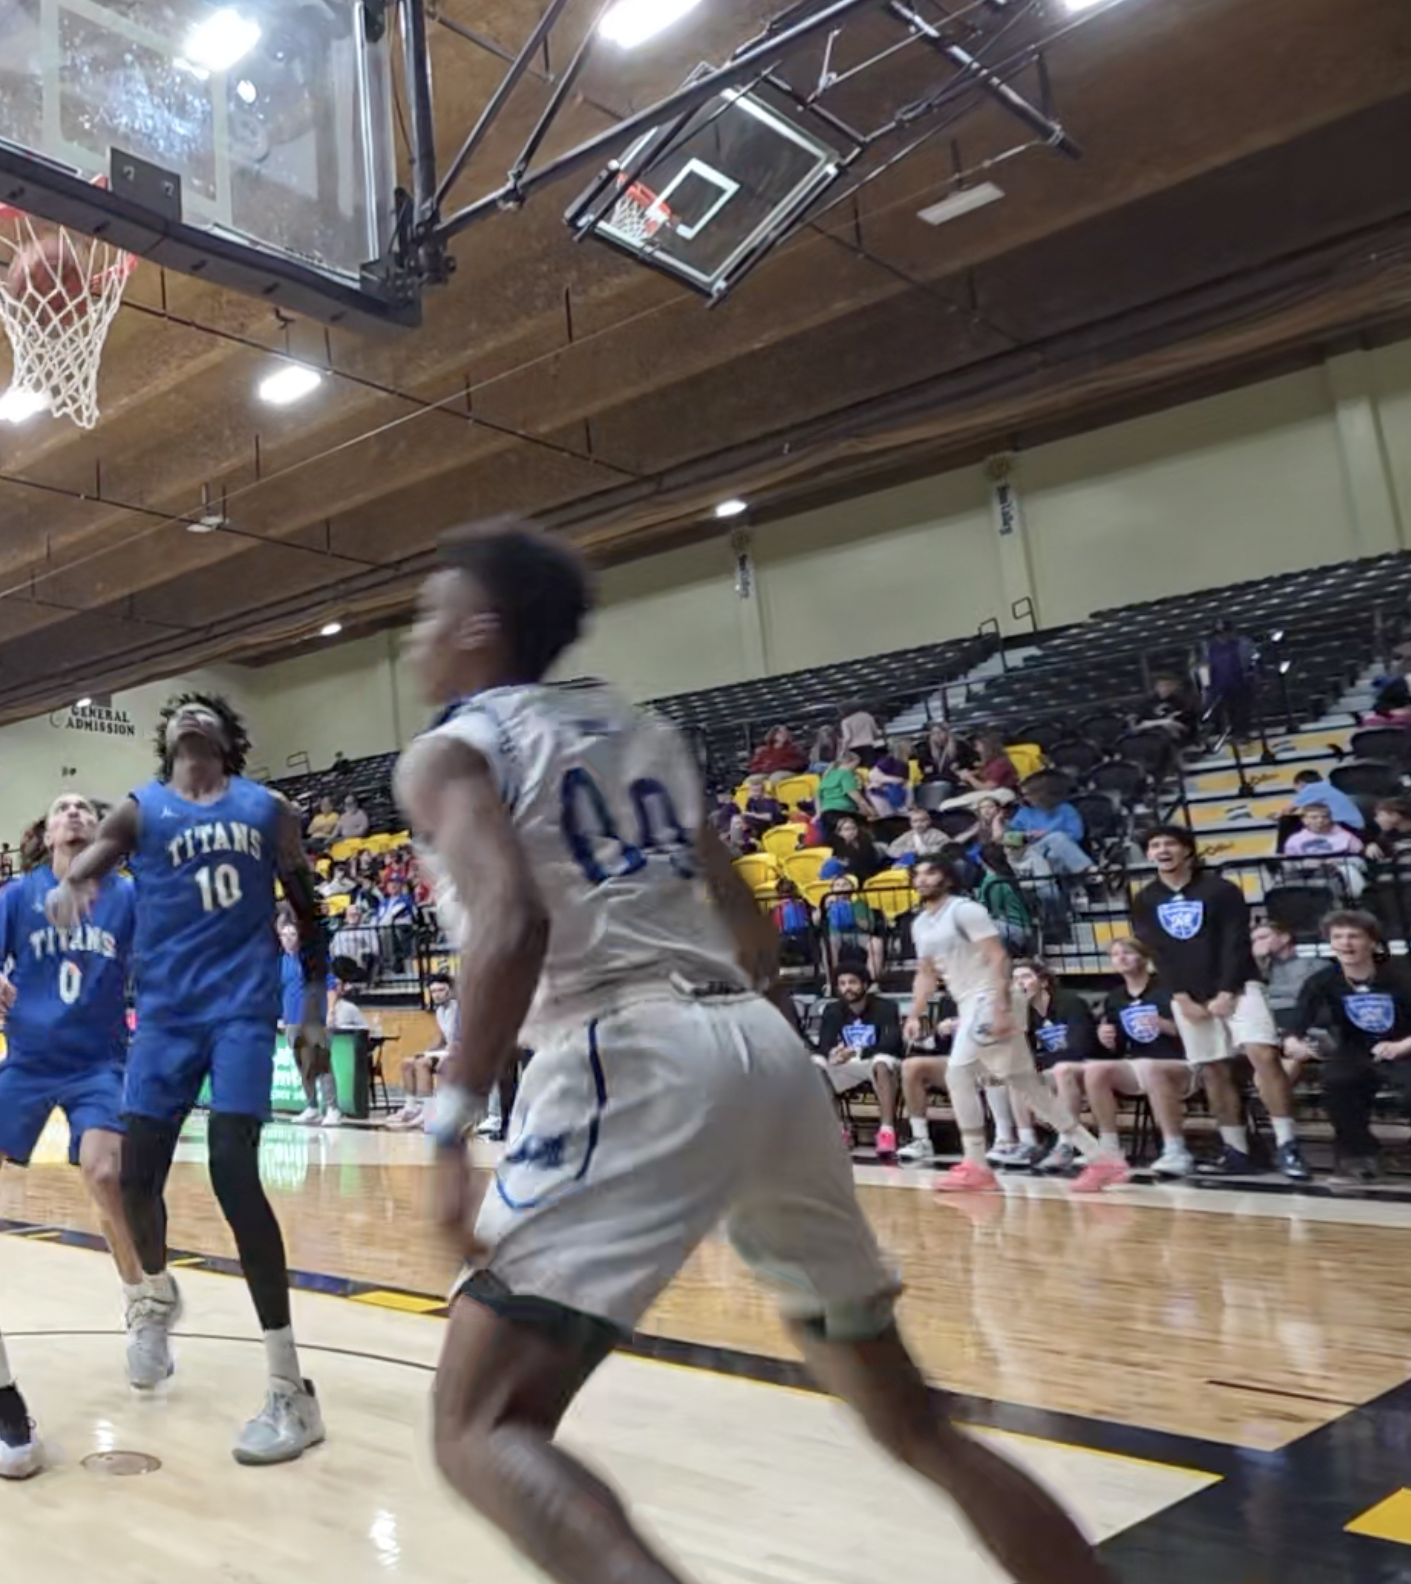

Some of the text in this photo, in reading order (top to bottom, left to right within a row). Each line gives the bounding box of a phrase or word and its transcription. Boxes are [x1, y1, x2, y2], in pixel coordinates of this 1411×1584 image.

[65, 716, 135, 737] ADMISSION
[71, 705, 130, 722] GENERAL
[168, 821, 262, 868] TITANS
[194, 863, 243, 912] 10
[29, 923, 118, 961] TITANS
[59, 958, 83, 1005] 0
